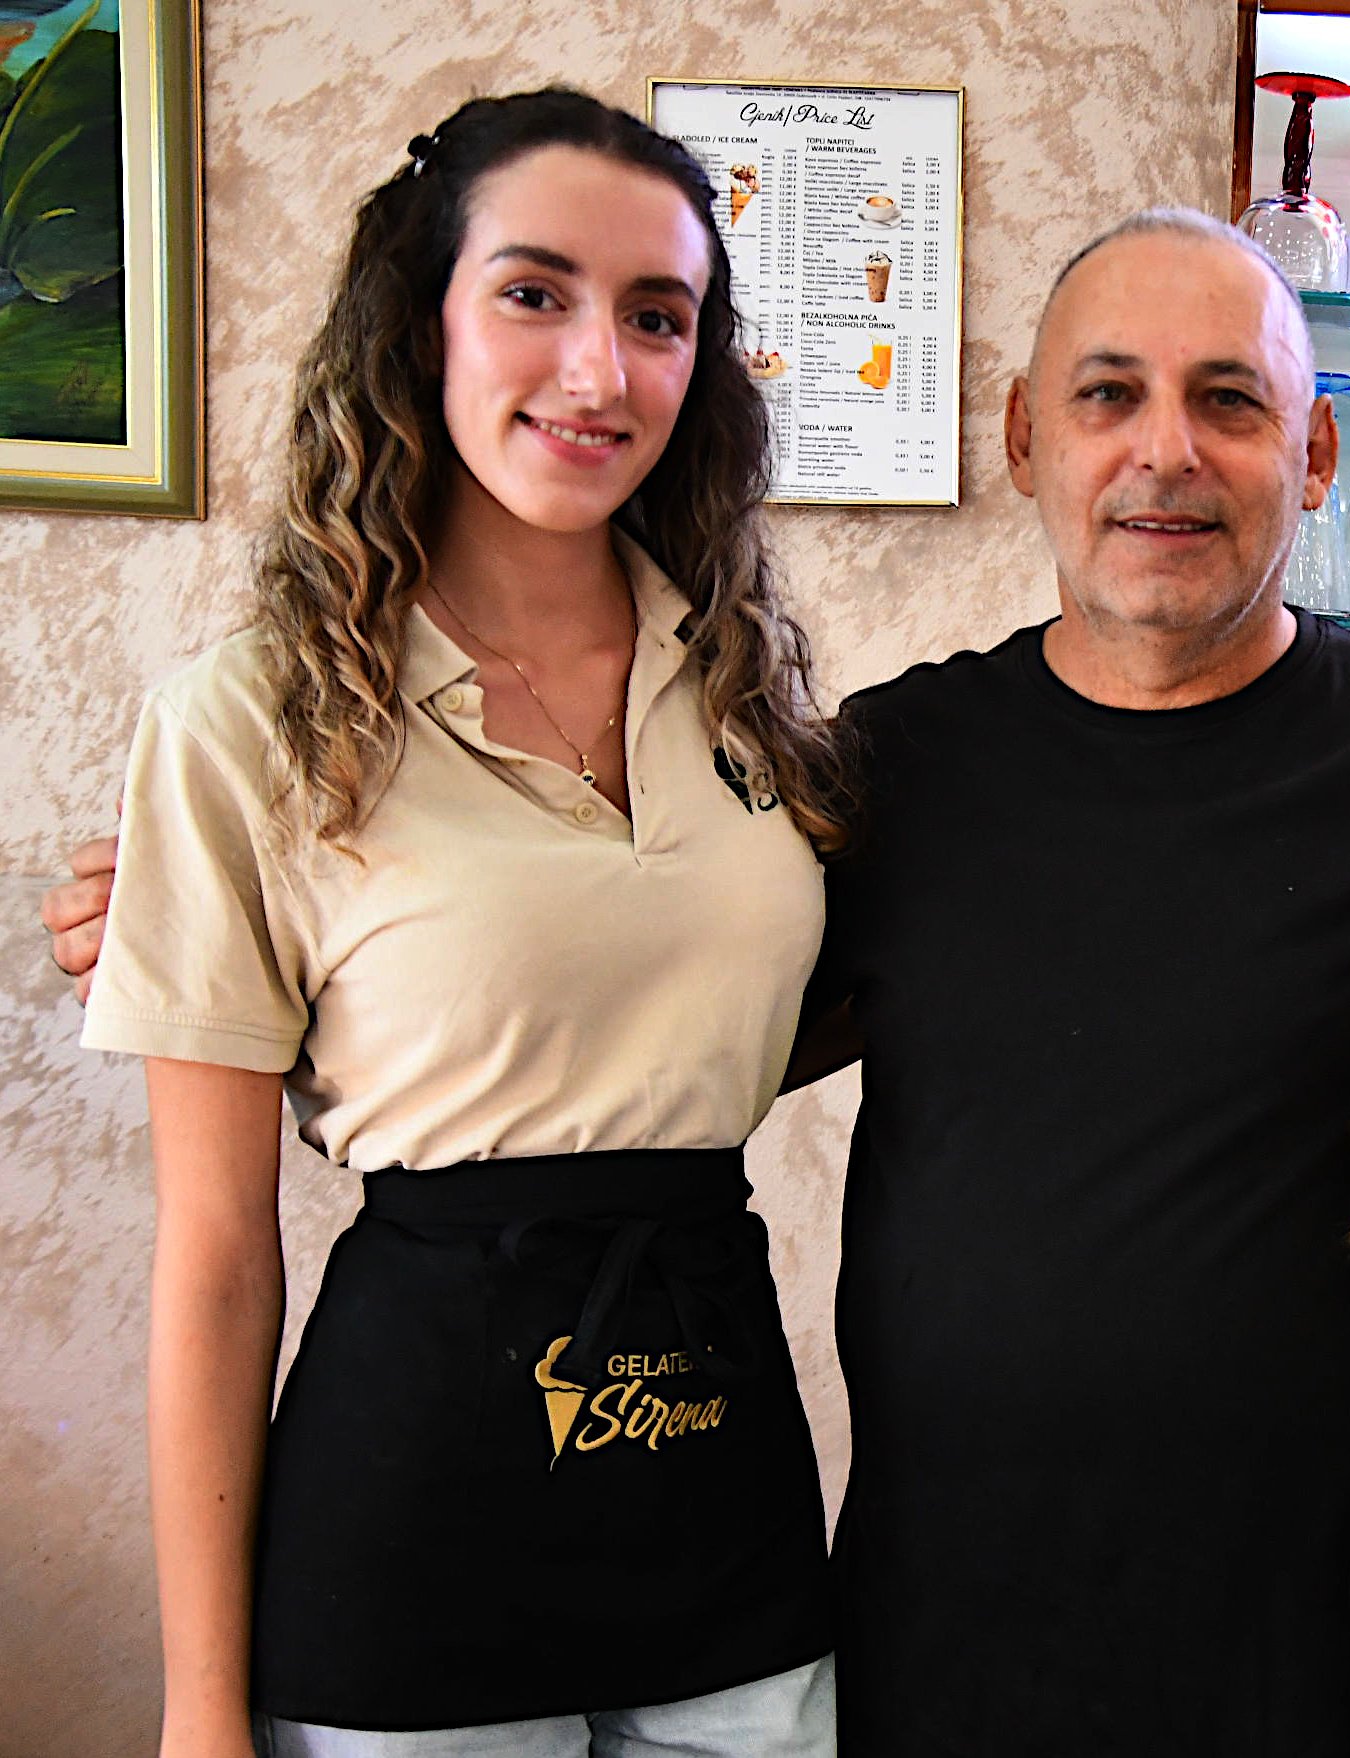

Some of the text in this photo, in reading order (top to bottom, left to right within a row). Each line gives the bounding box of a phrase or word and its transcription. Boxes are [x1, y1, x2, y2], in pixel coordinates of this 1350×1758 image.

[837, 146, 876, 154] BEVERAGES
[607, 1352, 693, 1377] GELATE
[575, 1378, 728, 1451] Sirena
